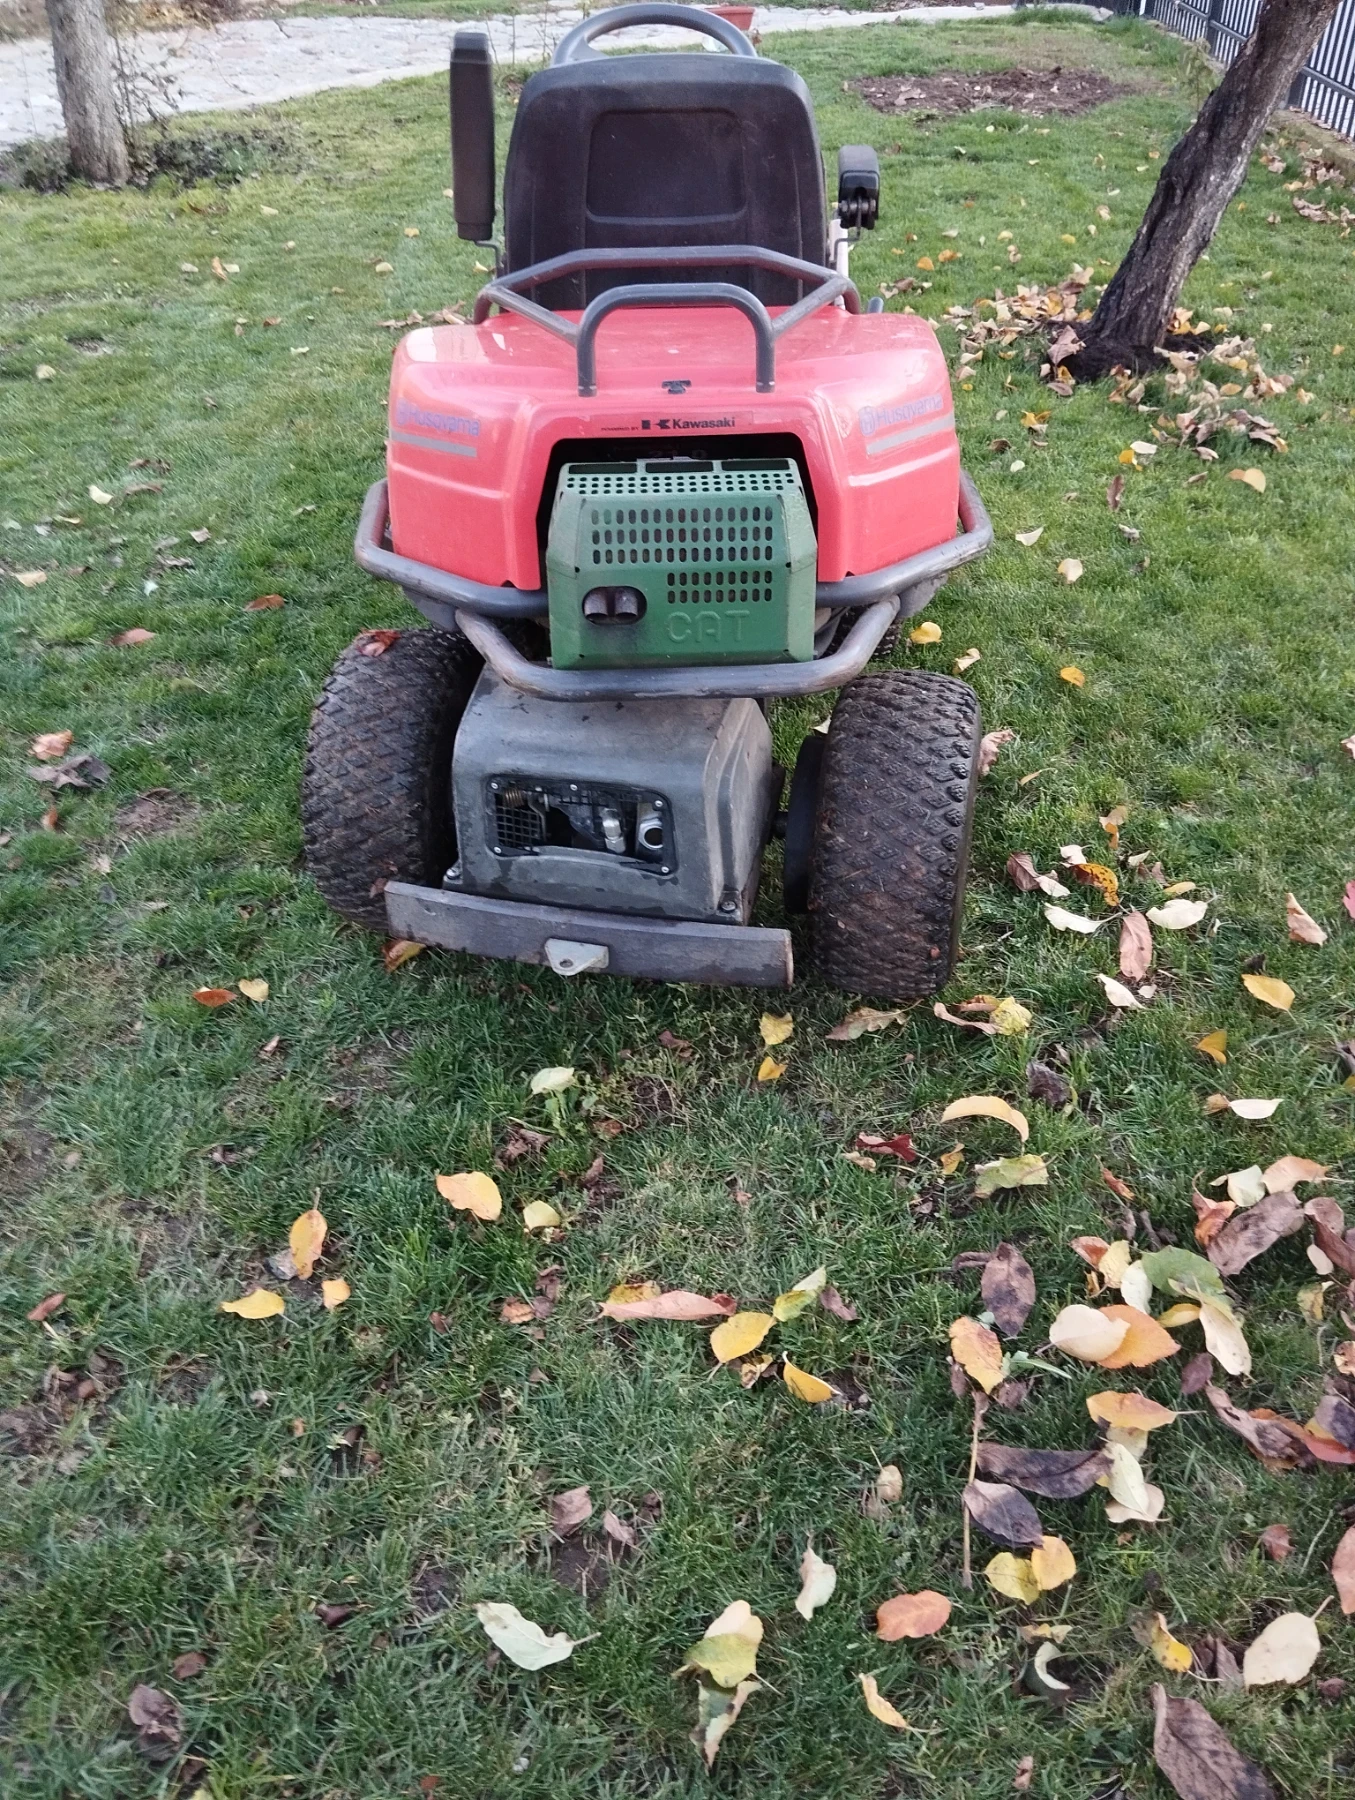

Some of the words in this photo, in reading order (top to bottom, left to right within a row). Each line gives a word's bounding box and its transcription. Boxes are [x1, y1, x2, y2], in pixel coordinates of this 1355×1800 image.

[672, 417, 735, 430] Kawasaki
[876, 394, 943, 426] Husqvarna
[667, 610, 750, 642] CAT
